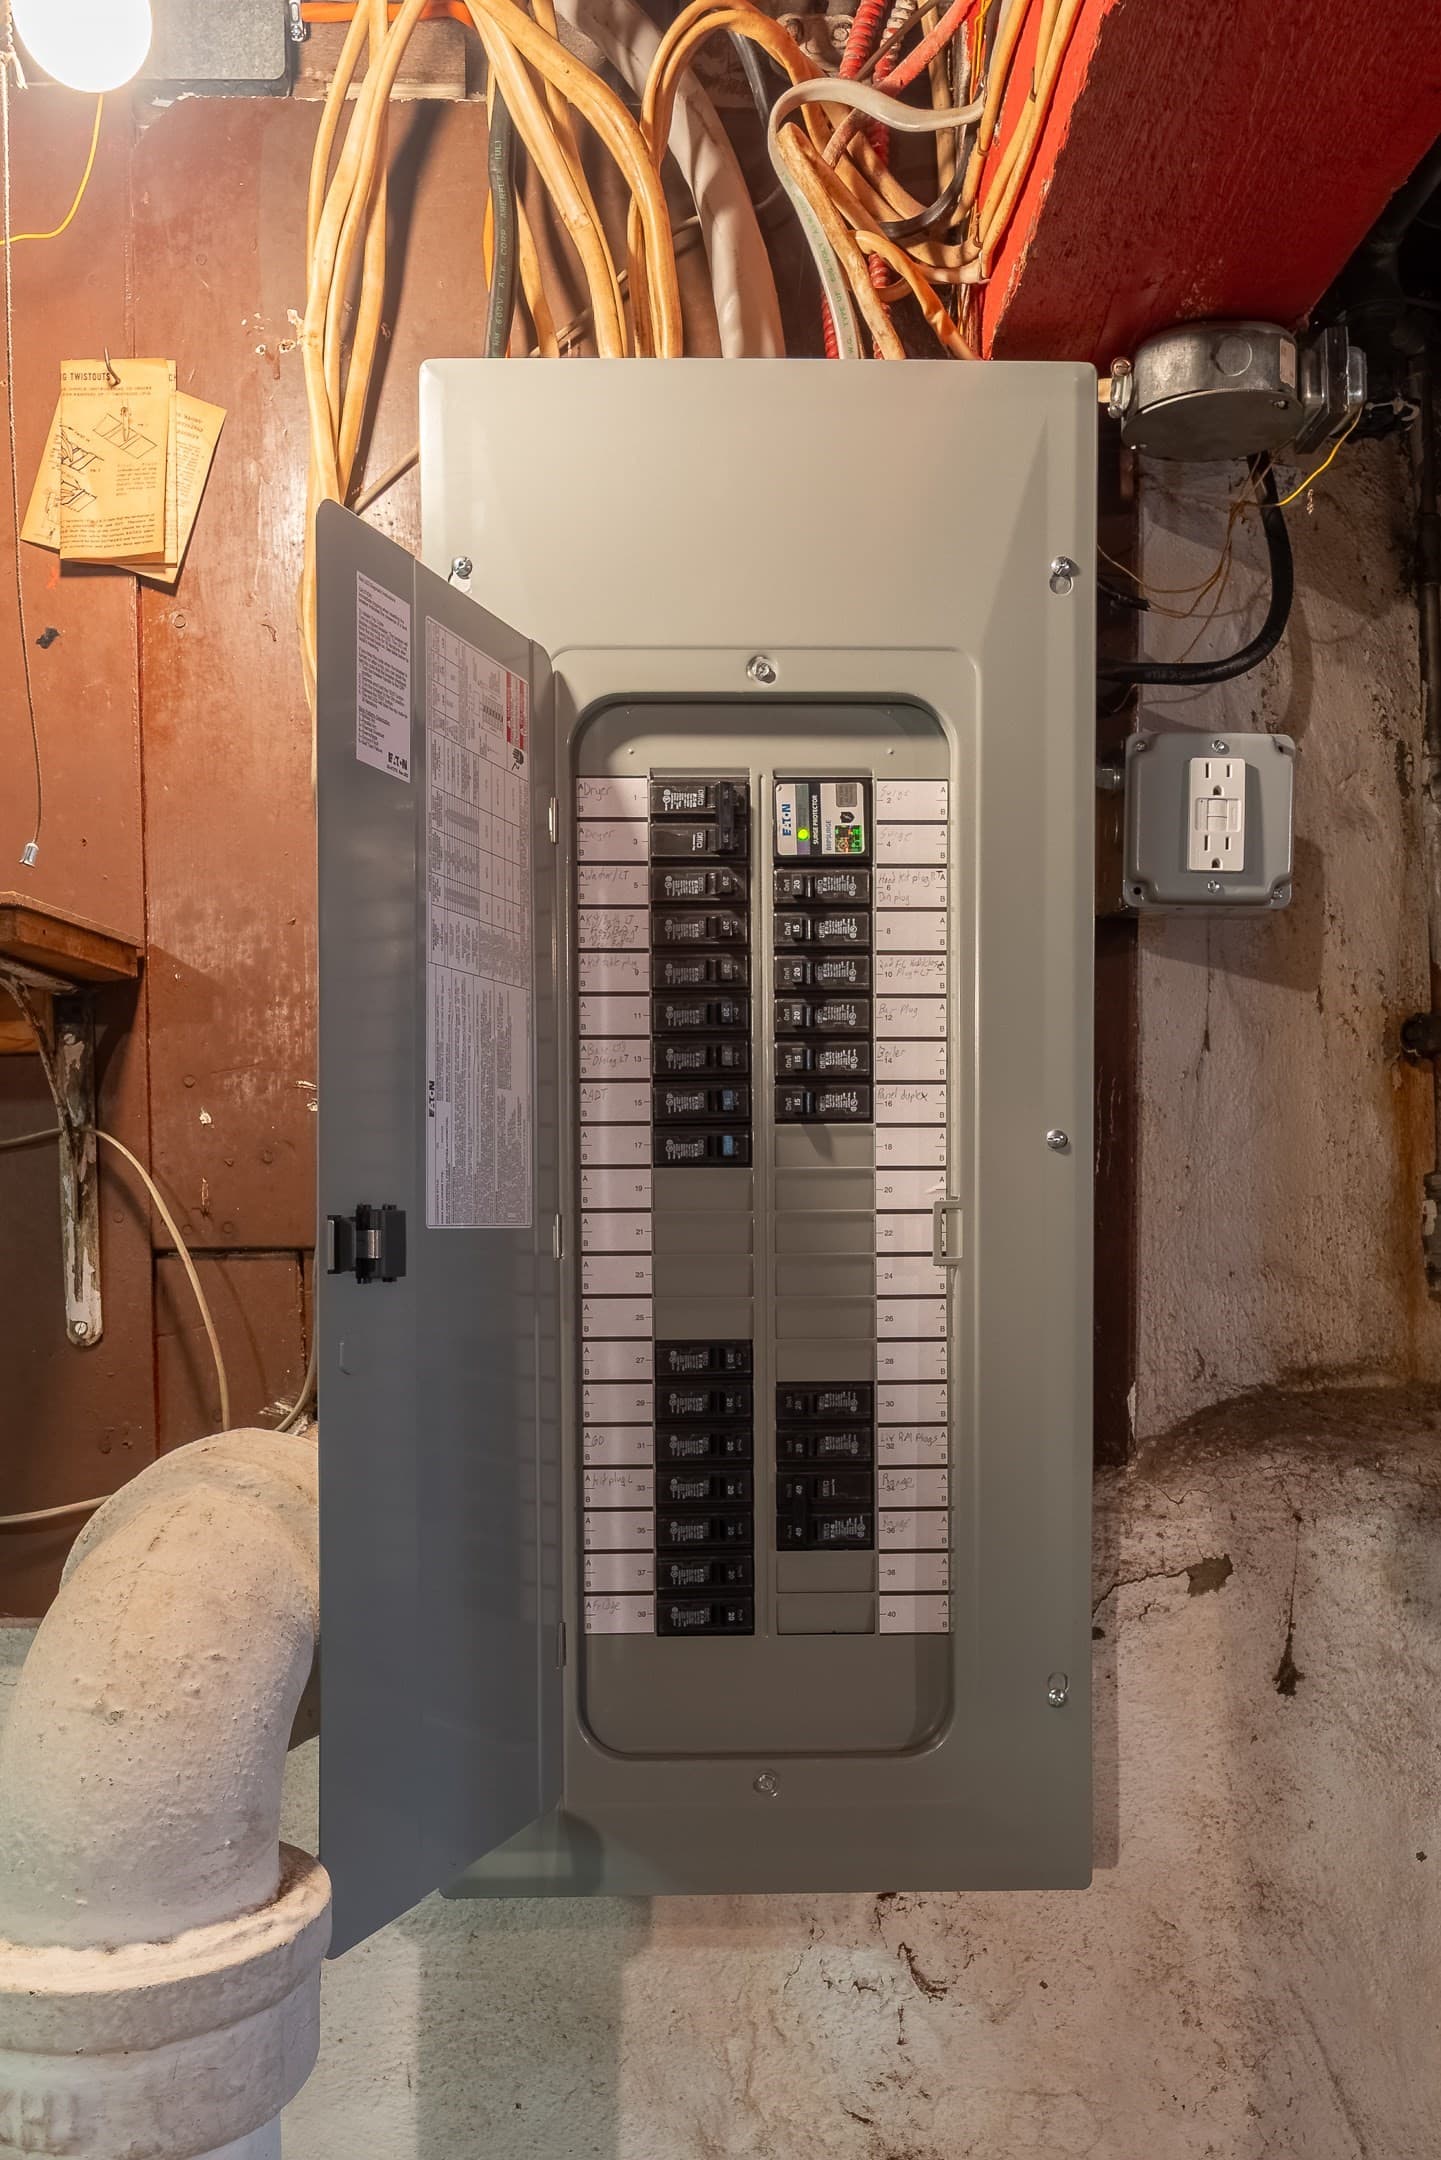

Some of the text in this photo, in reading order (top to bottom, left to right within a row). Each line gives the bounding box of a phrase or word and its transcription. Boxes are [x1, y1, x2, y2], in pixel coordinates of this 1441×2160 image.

[70, 372, 111, 381] TWISTOUTS
[811, 794, 819, 827] PROTECTOR
[781, 803, 792, 836] EATON
[794, 880, 801, 889] 20
[792, 924, 800, 932] 15
[794, 967, 801, 977] 20
[794, 1010, 801, 1020] 20
[794, 1055, 801, 1063] 15
[900, 1088, 929, 1104] duplex
[794, 1098, 801, 1106] 15
